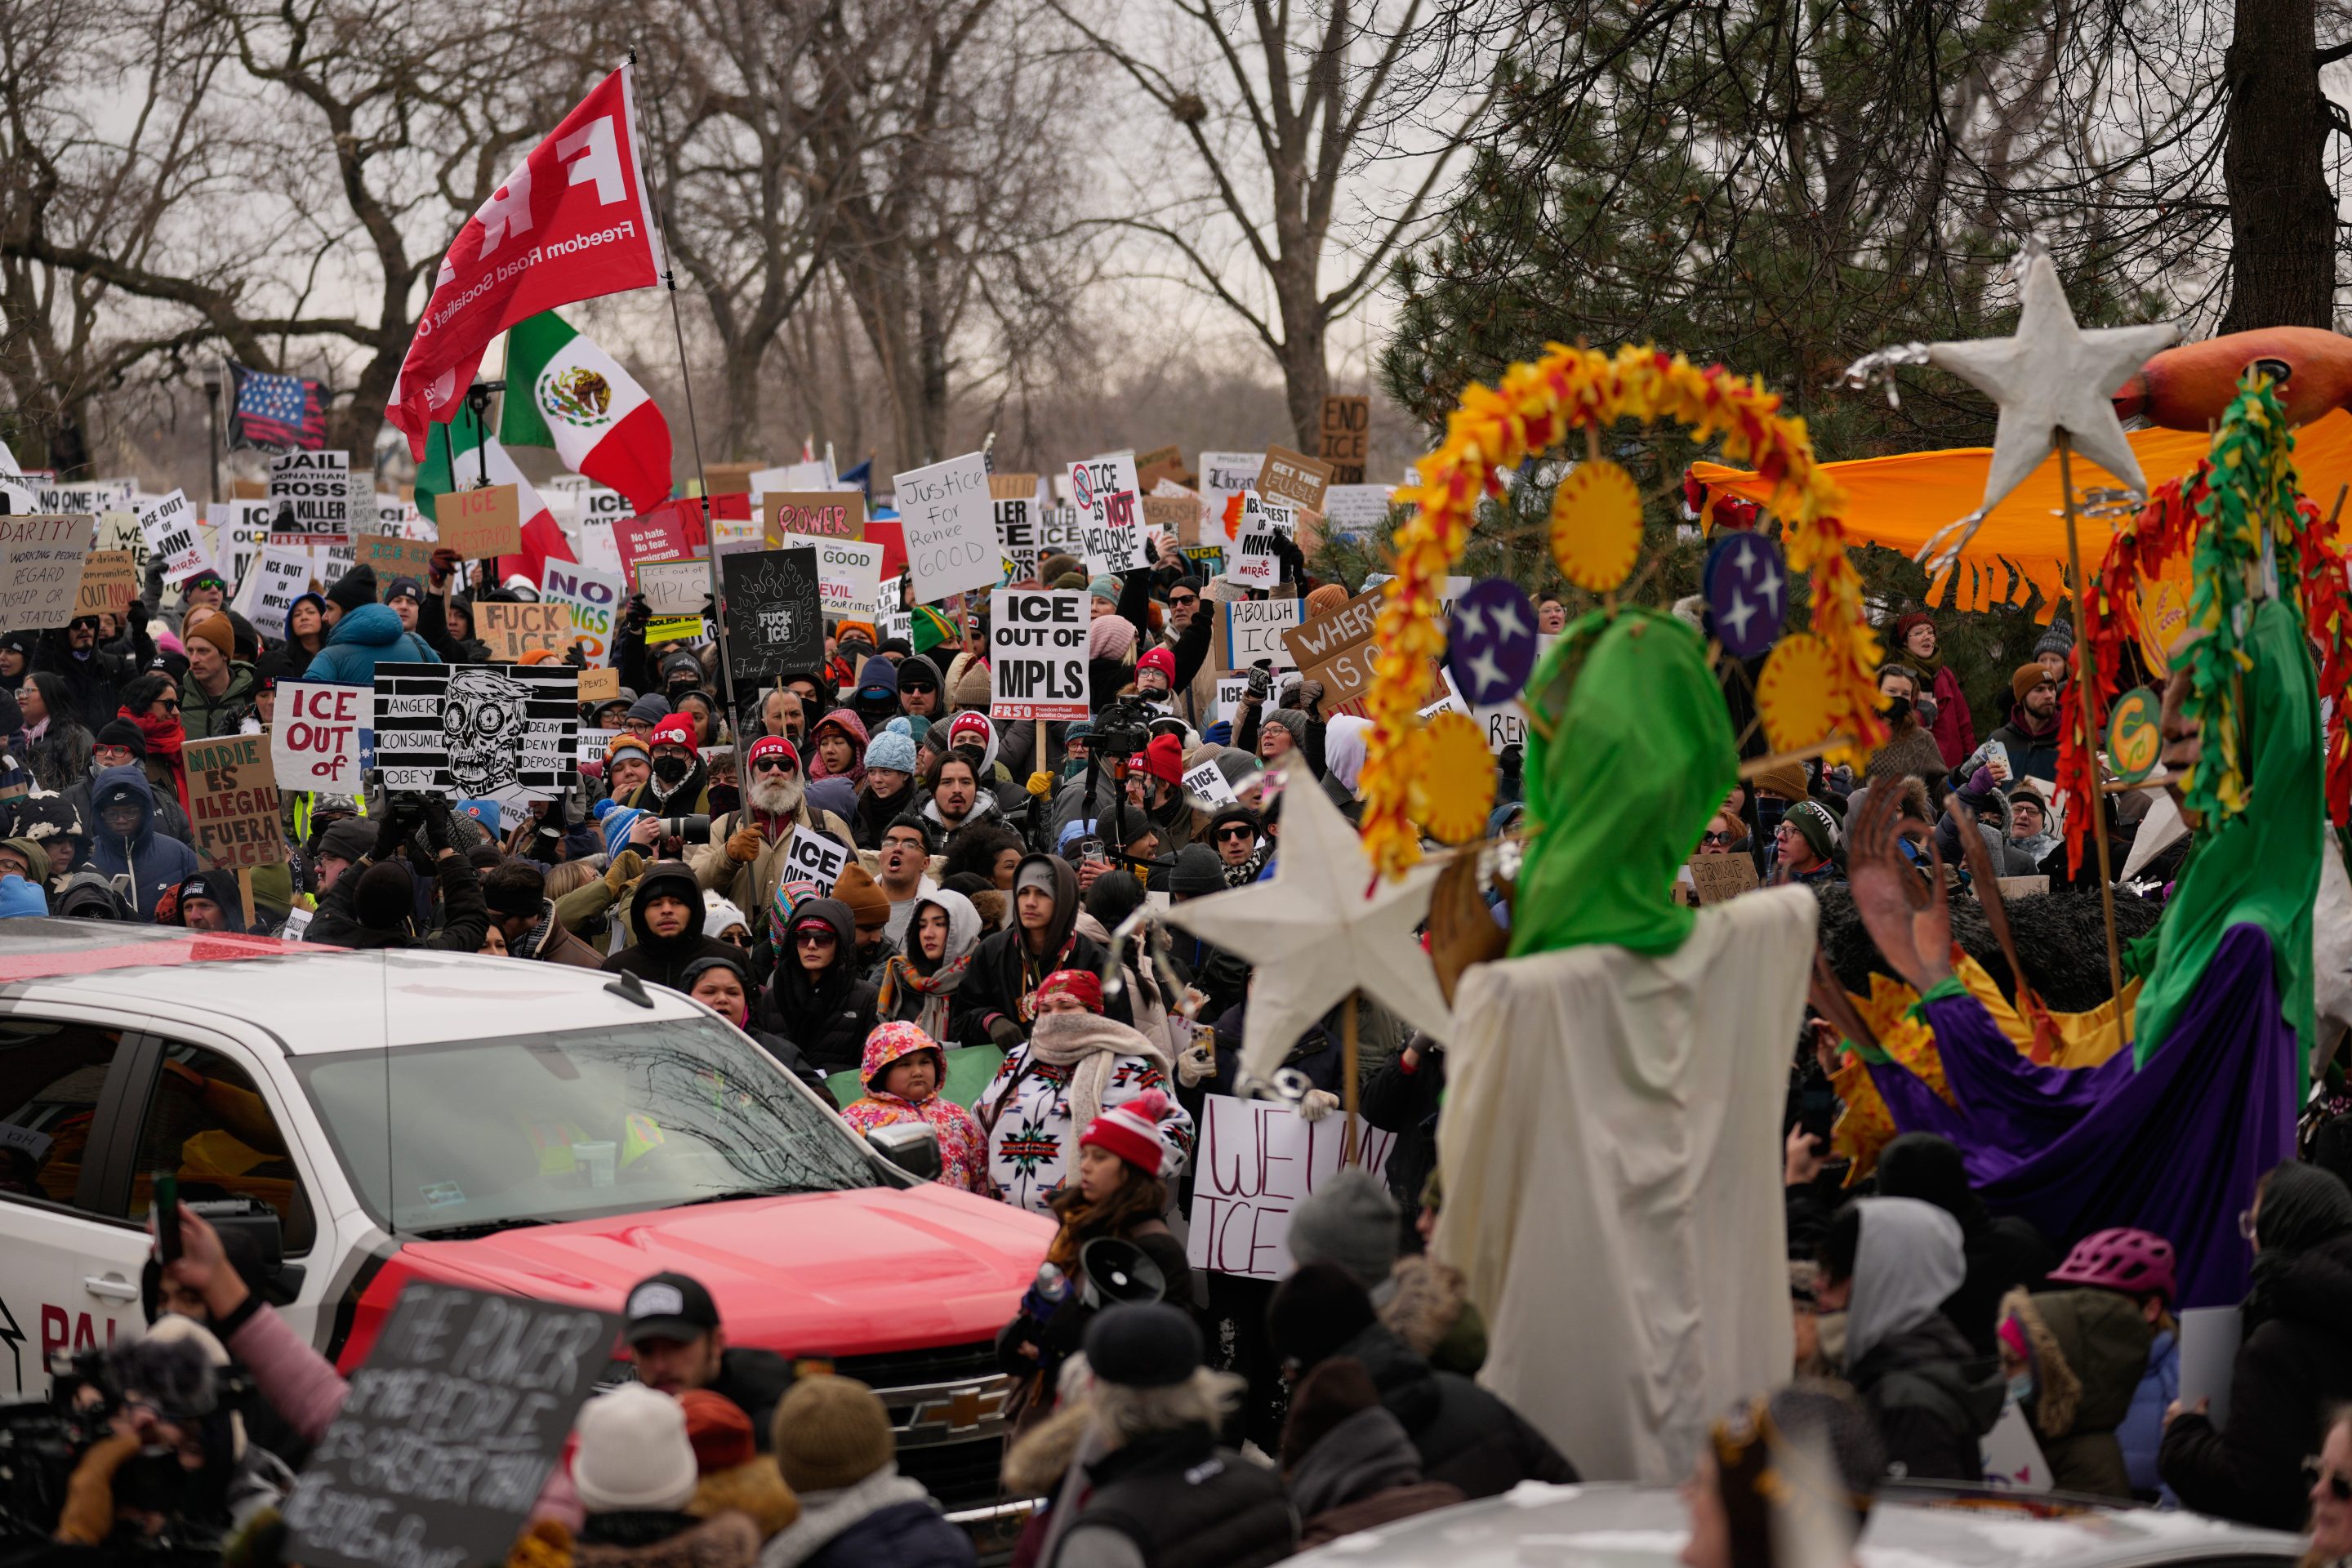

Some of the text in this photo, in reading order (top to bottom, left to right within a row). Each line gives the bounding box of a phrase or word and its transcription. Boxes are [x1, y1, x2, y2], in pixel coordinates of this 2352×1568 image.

[1325, 399, 1370, 432] END
[1324, 434, 1365, 459] ICE
[273, 454, 346, 471] JAIL
[272, 472, 346, 482] JONATHAN
[1089, 463, 1120, 494] ICE
[1272, 461, 1296, 478] GET
[1298, 470, 1322, 488] THE
[271, 483, 347, 497] ROSS
[902, 470, 983, 505] Justice
[296, 501, 346, 520] KILLER
[461, 488, 497, 518] ICE
[590, 496, 633, 513] ICE
[994, 500, 1027, 524] LER
[1092, 490, 1135, 528] IS NOT
[1246, 497, 1259, 514] ICE
[140, 497, 184, 530] ICE OUT
[778, 504, 852, 535] POWER
[927, 505, 959, 525] For
[116, 525, 143, 544] WE
[161, 520, 172, 533] OF
[305, 521, 347, 534] ICE
[630, 528, 667, 542] No hate.
[1257, 519, 1267, 531] OF
[157, 529, 194, 556] MN!
[451, 525, 511, 551] GESTAPO
[909, 524, 963, 548] Renee
[1040, 526, 1082, 546] ICE
[1081, 524, 1138, 558] WELCOME
[1241, 534, 1273, 556] MN!
[369, 543, 403, 559] ICE
[635, 540, 669, 553] No fear.
[10, 550, 83, 564] WORKING PEOPLE
[168, 556, 202, 574] MIRAC
[630, 549, 680, 567] Immigrants
[823, 550, 871, 567] GOOD
[918, 541, 985, 577] GOOD
[1105, 550, 1134, 572] HERE
[12, 567, 65, 587] REGARD
[82, 568, 132, 580] ommunities
[265, 560, 281, 573] ICE
[283, 564, 303, 578] OUT
[641, 567, 666, 577] ICE
[693, 566, 704, 574] of
[1239, 566, 1270, 577] MIRAC
[46, 588, 64, 604] OR
[82, 583, 136, 608] OUT NOW
[278, 581, 288, 591] OF
[548, 569, 613, 604] NO
[643, 579, 708, 606] MPLS
[819, 583, 853, 599] EVIL
[262, 594, 291, 610] MPLS
[831, 599, 848, 608] OUR
[849, 602, 875, 612] CITIES
[1008, 595, 1079, 623] ICE
[1232, 600, 1294, 624] ABOLISH
[18, 610, 66, 625] STATUS
[486, 605, 561, 633] FUCK
[644, 617, 681, 628] ABOLISH
[757, 610, 792, 628] FUCK
[1297, 593, 1388, 657] WHERE
[767, 625, 791, 644] ICE
[996, 628, 1087, 648] OUT OF
[1241, 627, 1290, 653] ICE
[735, 655, 823, 679] Fuck Trump!
[1325, 657, 1362, 692] IS
[584, 679, 608, 688] PENIS
[998, 660, 1084, 700] MPLS
[292, 688, 358, 721] ICE
[1221, 687, 1243, 703] ICE
[389, 697, 438, 714] ANGER
[529, 721, 561, 733] DELAY
[286, 722, 354, 754] OUT
[381, 733, 444, 750] CONSUME
[525, 738, 558, 751] DENY
[187, 740, 261, 773] NADIE
[522, 755, 566, 769] DEPOSE
[311, 754, 348, 782] of
[385, 769, 433, 785] OBEY
[204, 765, 238, 792] ES
[195, 786, 279, 820] ILEGAL
[199, 815, 278, 850] FUERA
[226, 840, 283, 866] ICE!
[790, 835, 842, 880] ICE
[783, 865, 813, 885] OUT
[1694, 859, 1744, 882] TRUMP
[1209, 1098, 1294, 1200] WE
[1192, 1193, 1290, 1275] ICE
